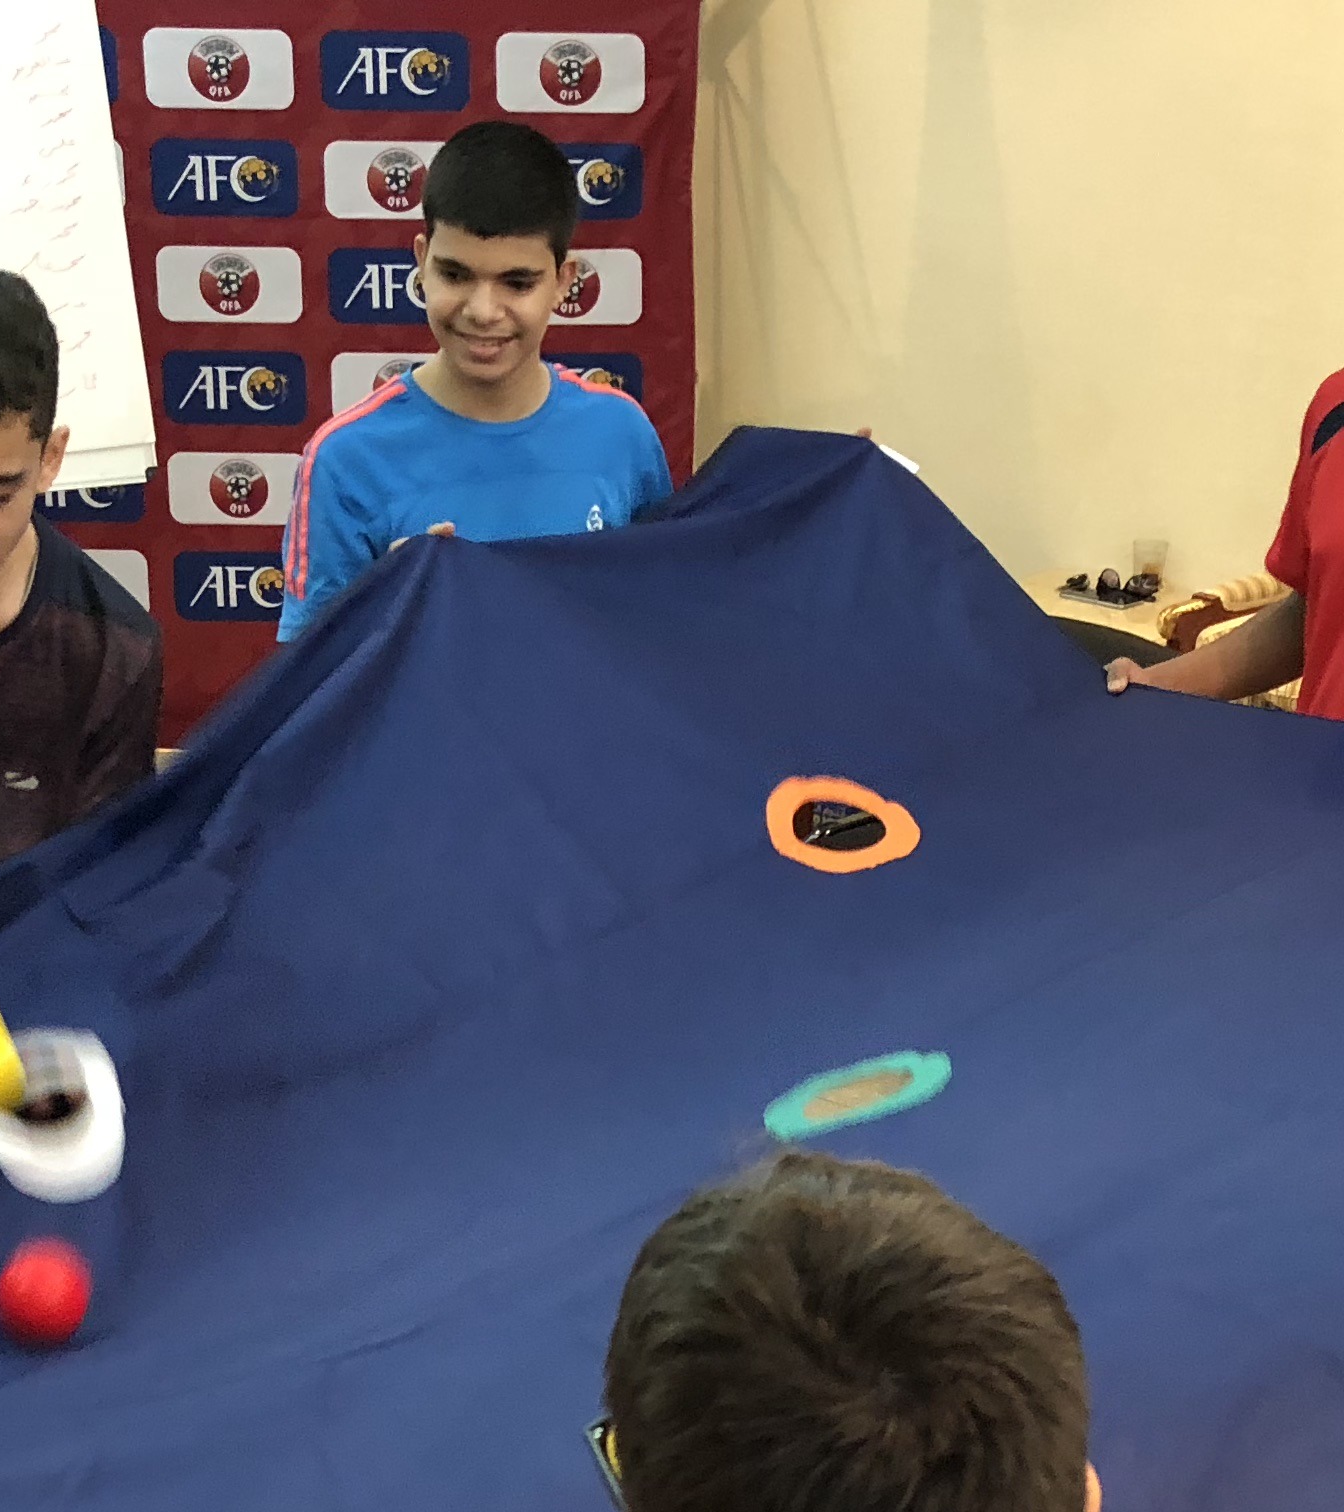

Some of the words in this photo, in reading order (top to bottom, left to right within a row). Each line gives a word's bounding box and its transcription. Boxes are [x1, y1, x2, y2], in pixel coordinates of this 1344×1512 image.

[337, 47, 437, 95] AFC
[167, 155, 267, 201] AFC
[179, 366, 275, 410] AFC
[189, 566, 282, 608] AFC
